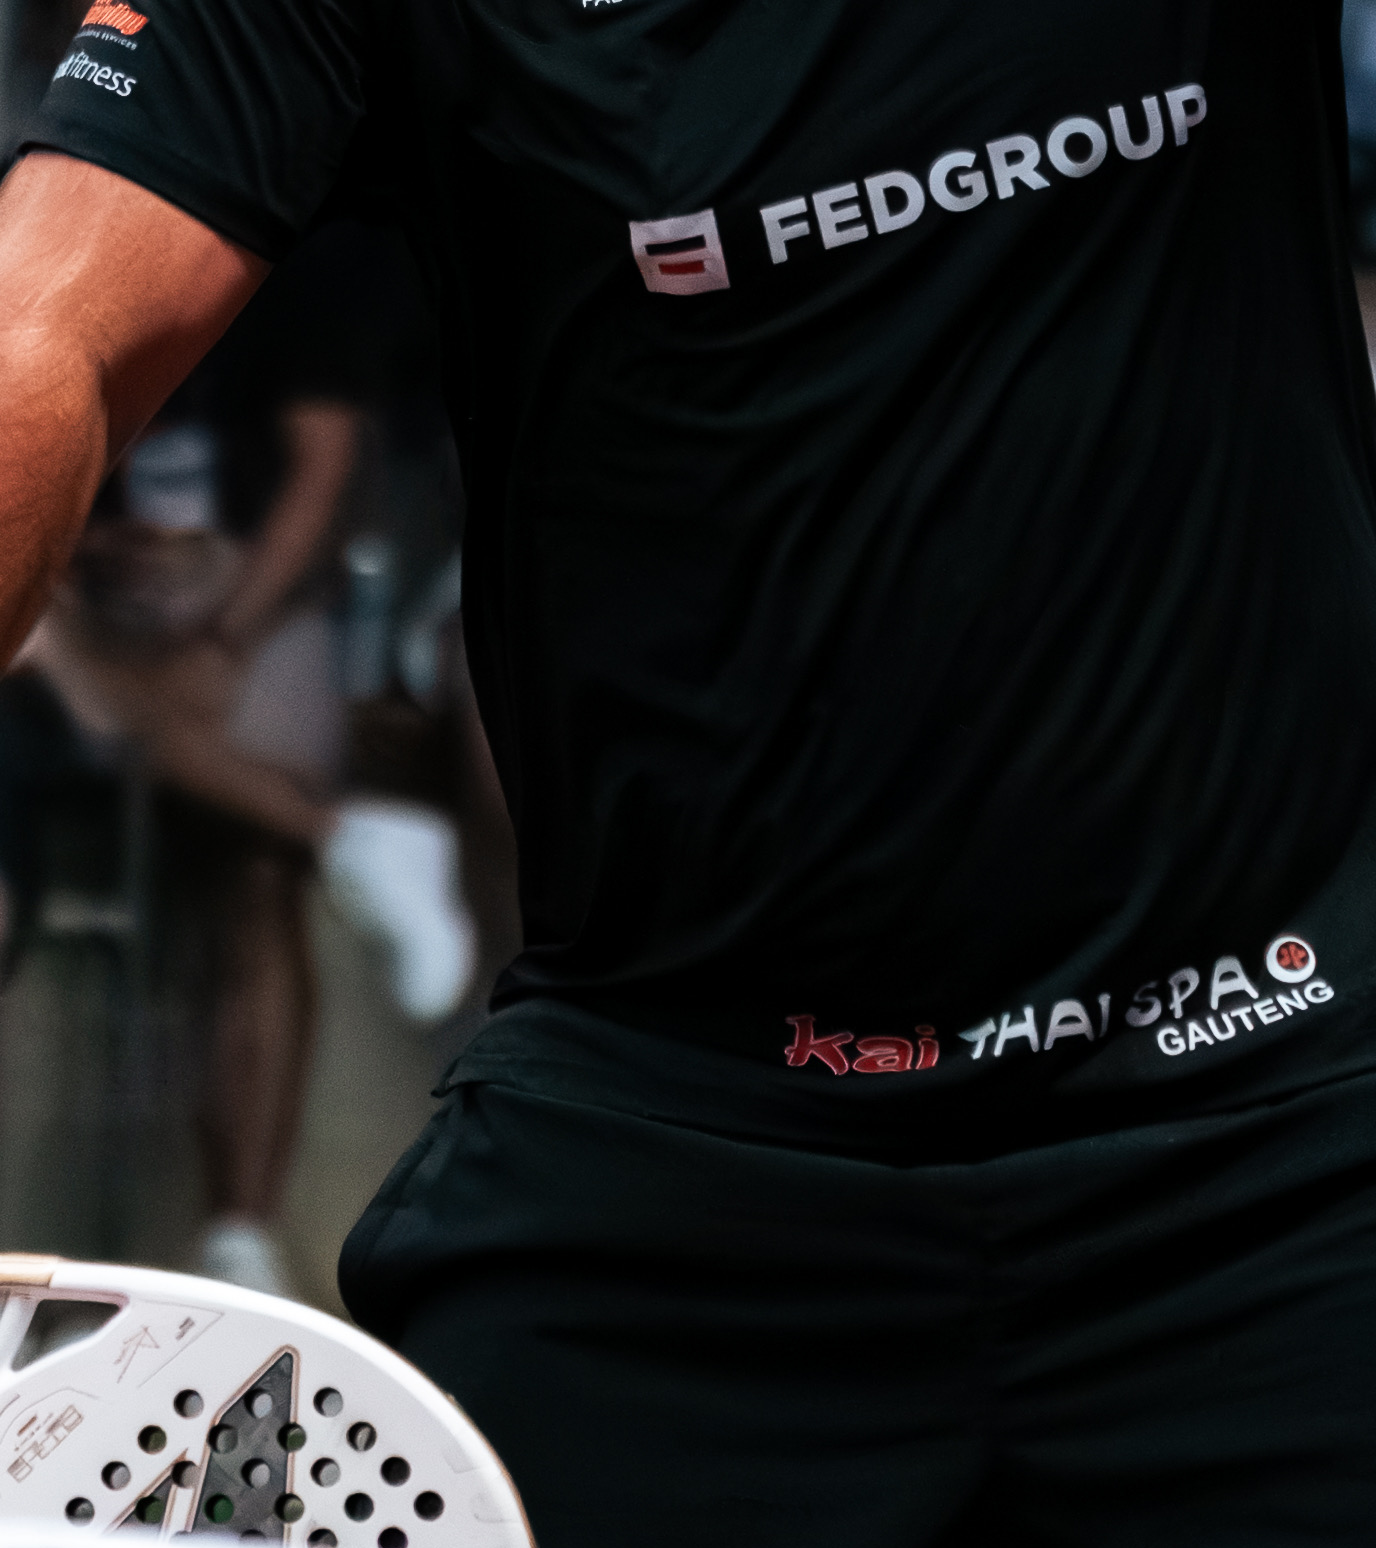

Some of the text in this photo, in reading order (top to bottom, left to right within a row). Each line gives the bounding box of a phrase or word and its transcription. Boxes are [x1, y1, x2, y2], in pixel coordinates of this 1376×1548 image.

[759, 82, 1210, 266] FEDGROUP
[957, 992, 1112, 1061] THAI
[1124, 955, 1260, 1028] SPA
[1155, 979, 1336, 1058] GAUTENG
